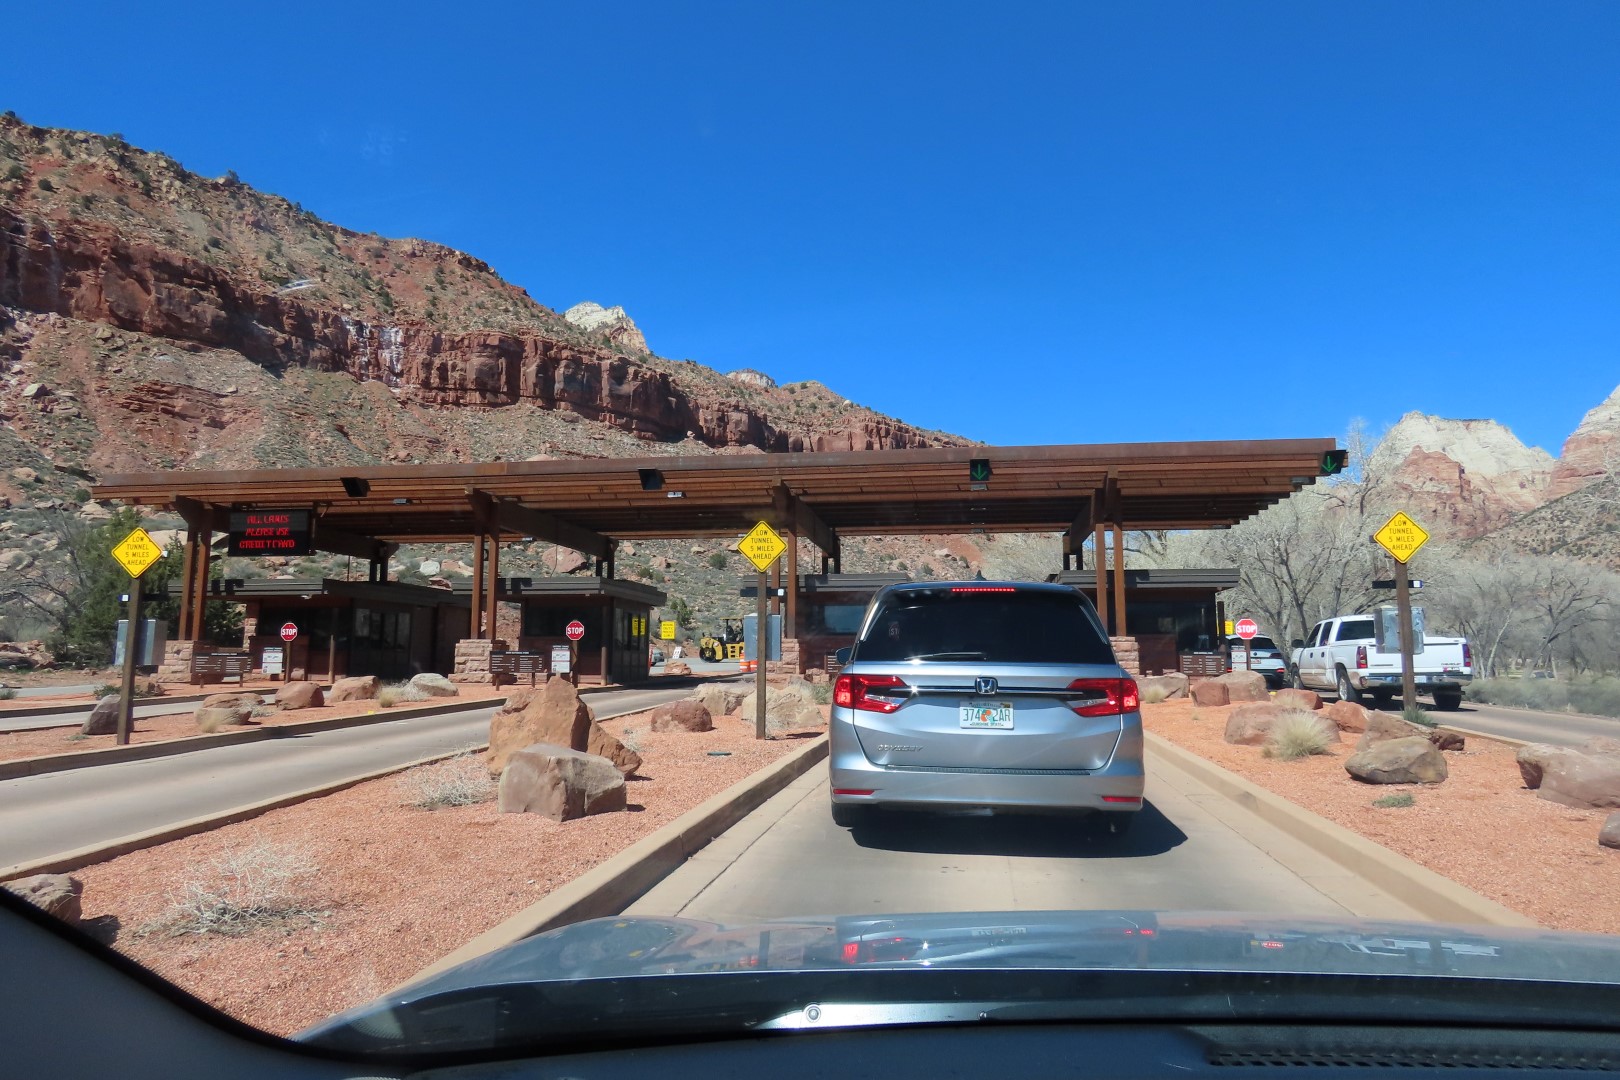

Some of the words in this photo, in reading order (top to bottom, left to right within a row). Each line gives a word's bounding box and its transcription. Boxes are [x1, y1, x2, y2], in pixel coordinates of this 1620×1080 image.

[247, 515, 262, 524] ALL
[264, 515, 289, 524] LANES
[246, 527, 275, 537] PLEASE
[276, 527, 290, 536] USE
[127, 543, 150, 551] TUNNEL
[239, 540, 271, 549] CREDIT
[282, 628, 297, 636] STOP
[567, 627, 583, 635] STOP
[1237, 625, 1257, 634] STOP
